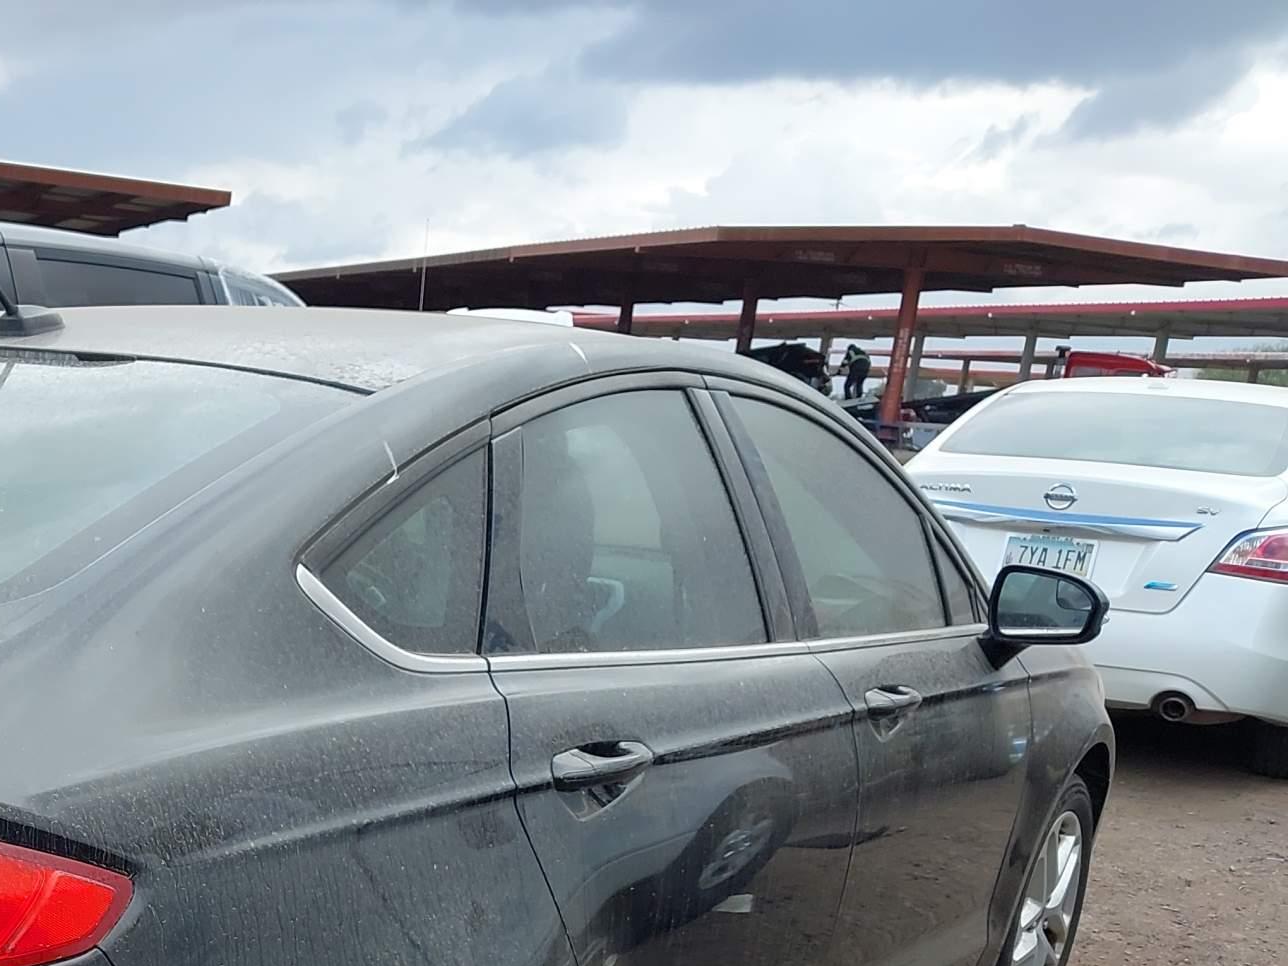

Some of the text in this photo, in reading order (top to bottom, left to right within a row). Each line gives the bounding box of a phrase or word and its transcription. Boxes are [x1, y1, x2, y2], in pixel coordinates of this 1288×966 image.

[919, 482, 972, 493] ALTIMA
[1018, 545, 1087, 572] 7YA 1FM
